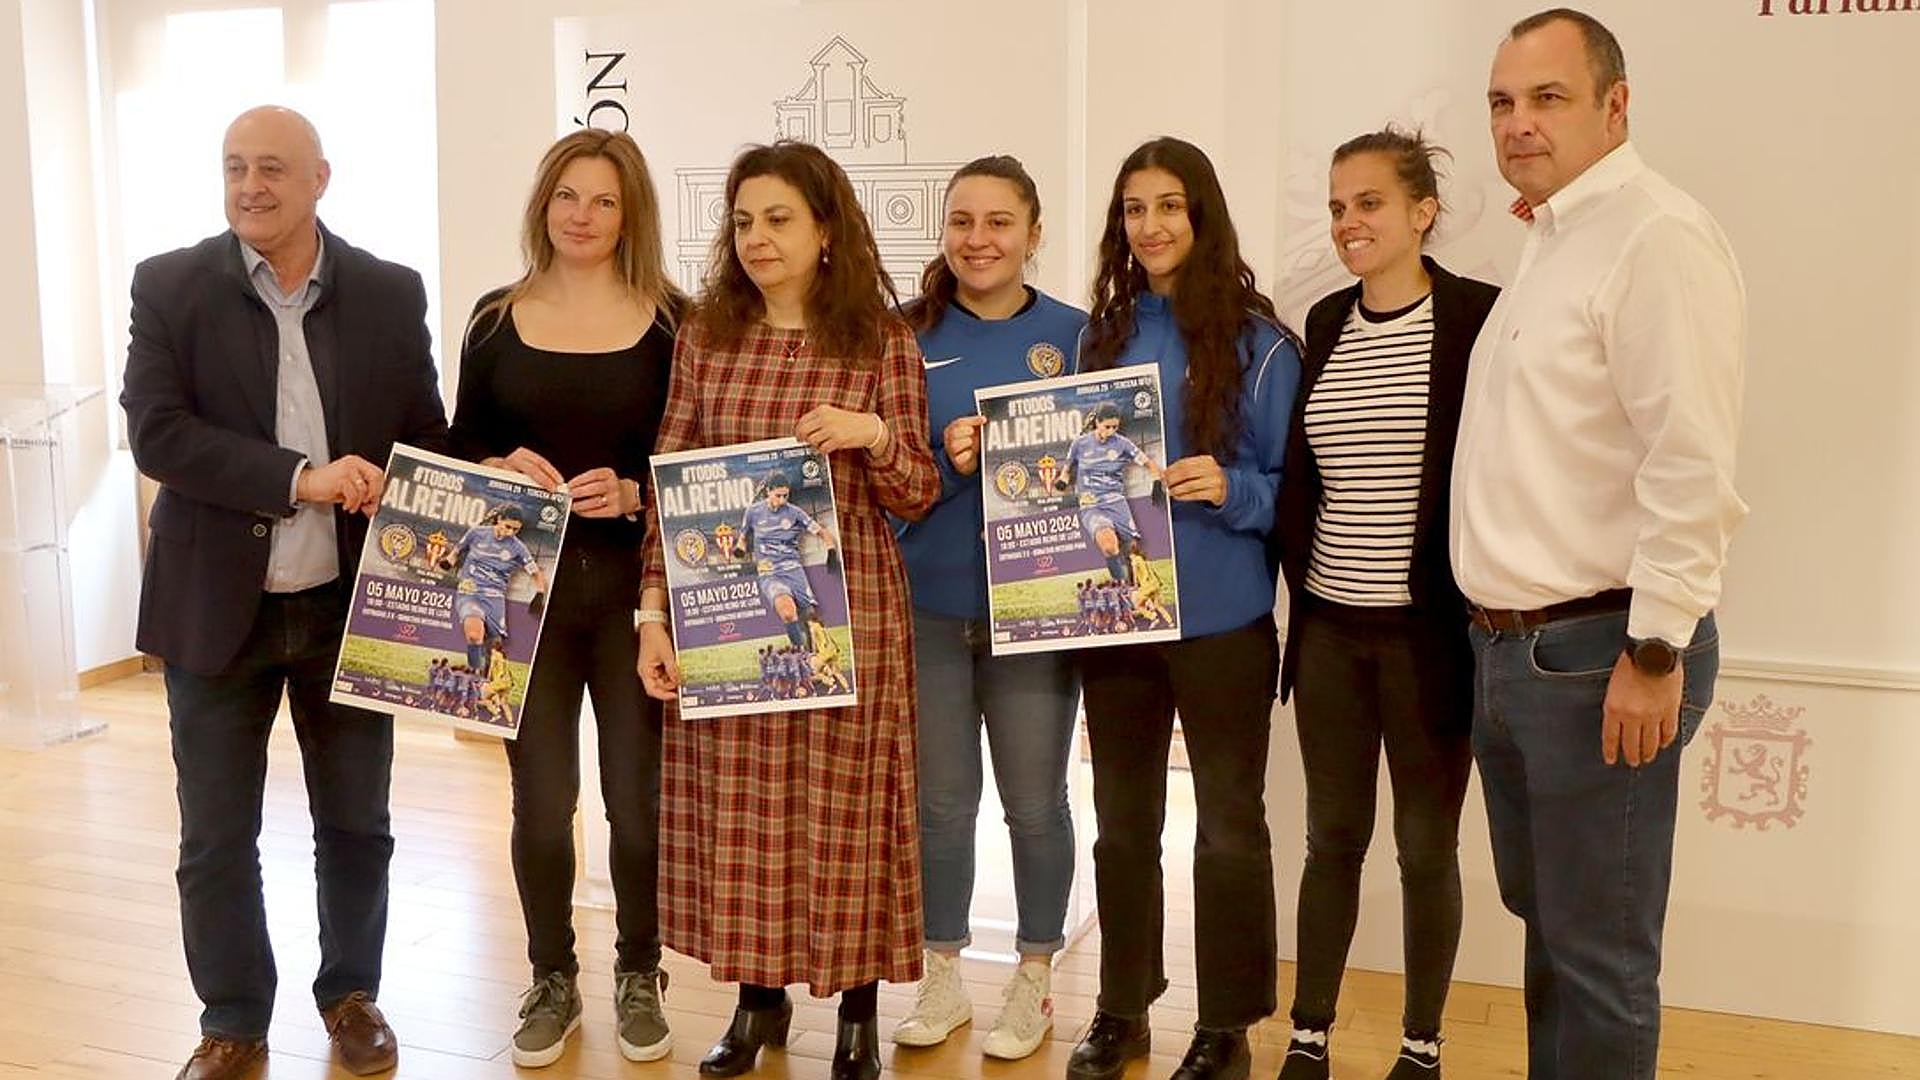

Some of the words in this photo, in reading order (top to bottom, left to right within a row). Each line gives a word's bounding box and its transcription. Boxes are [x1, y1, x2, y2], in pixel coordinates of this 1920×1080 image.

[1008, 395, 1056, 417] #TODOS
[987, 410, 1084, 450] ALREINO
[413, 466, 465, 492] #TODOS
[682, 462, 728, 484] #TODOS
[381, 477, 486, 526] ALREINO
[664, 477, 754, 517] ALREINO
[996, 524, 1012, 541] 05
[1013, 519, 1047, 539] MAYO
[1049, 513, 1080, 533] 2024
[367, 580, 384, 597] 05
[384, 584, 420, 604] MAYO
[421, 590, 453, 609] 2024
[681, 591, 696, 608] 05
[696, 586, 728, 605] MAYO
[729, 581, 759, 599] 2024
